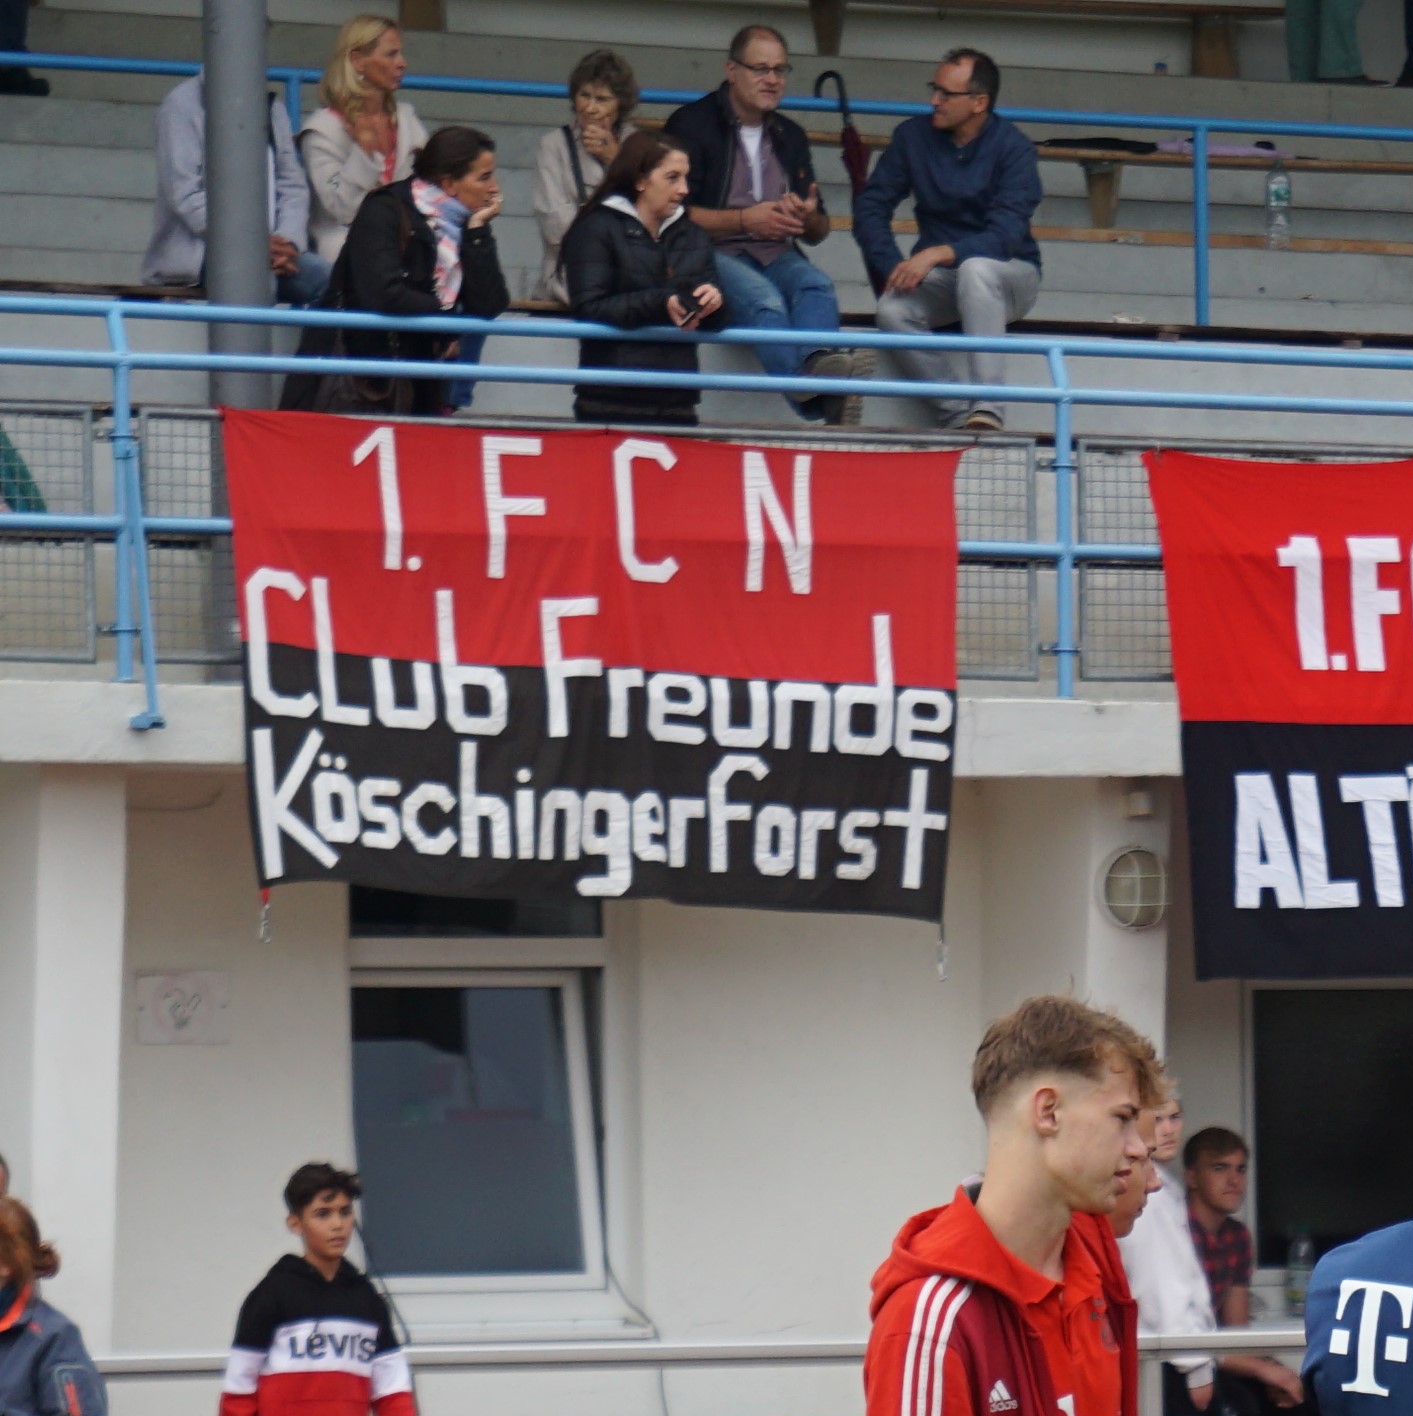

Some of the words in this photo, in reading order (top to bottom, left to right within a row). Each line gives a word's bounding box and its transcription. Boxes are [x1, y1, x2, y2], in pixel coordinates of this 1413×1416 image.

[352, 426, 422, 572] 1.
[482, 437, 546, 579] F
[613, 438, 679, 583] C
[742, 450, 813, 595] N
[538, 596, 954, 762] Freunde
[250, 727, 947, 897] Köschingerforst
